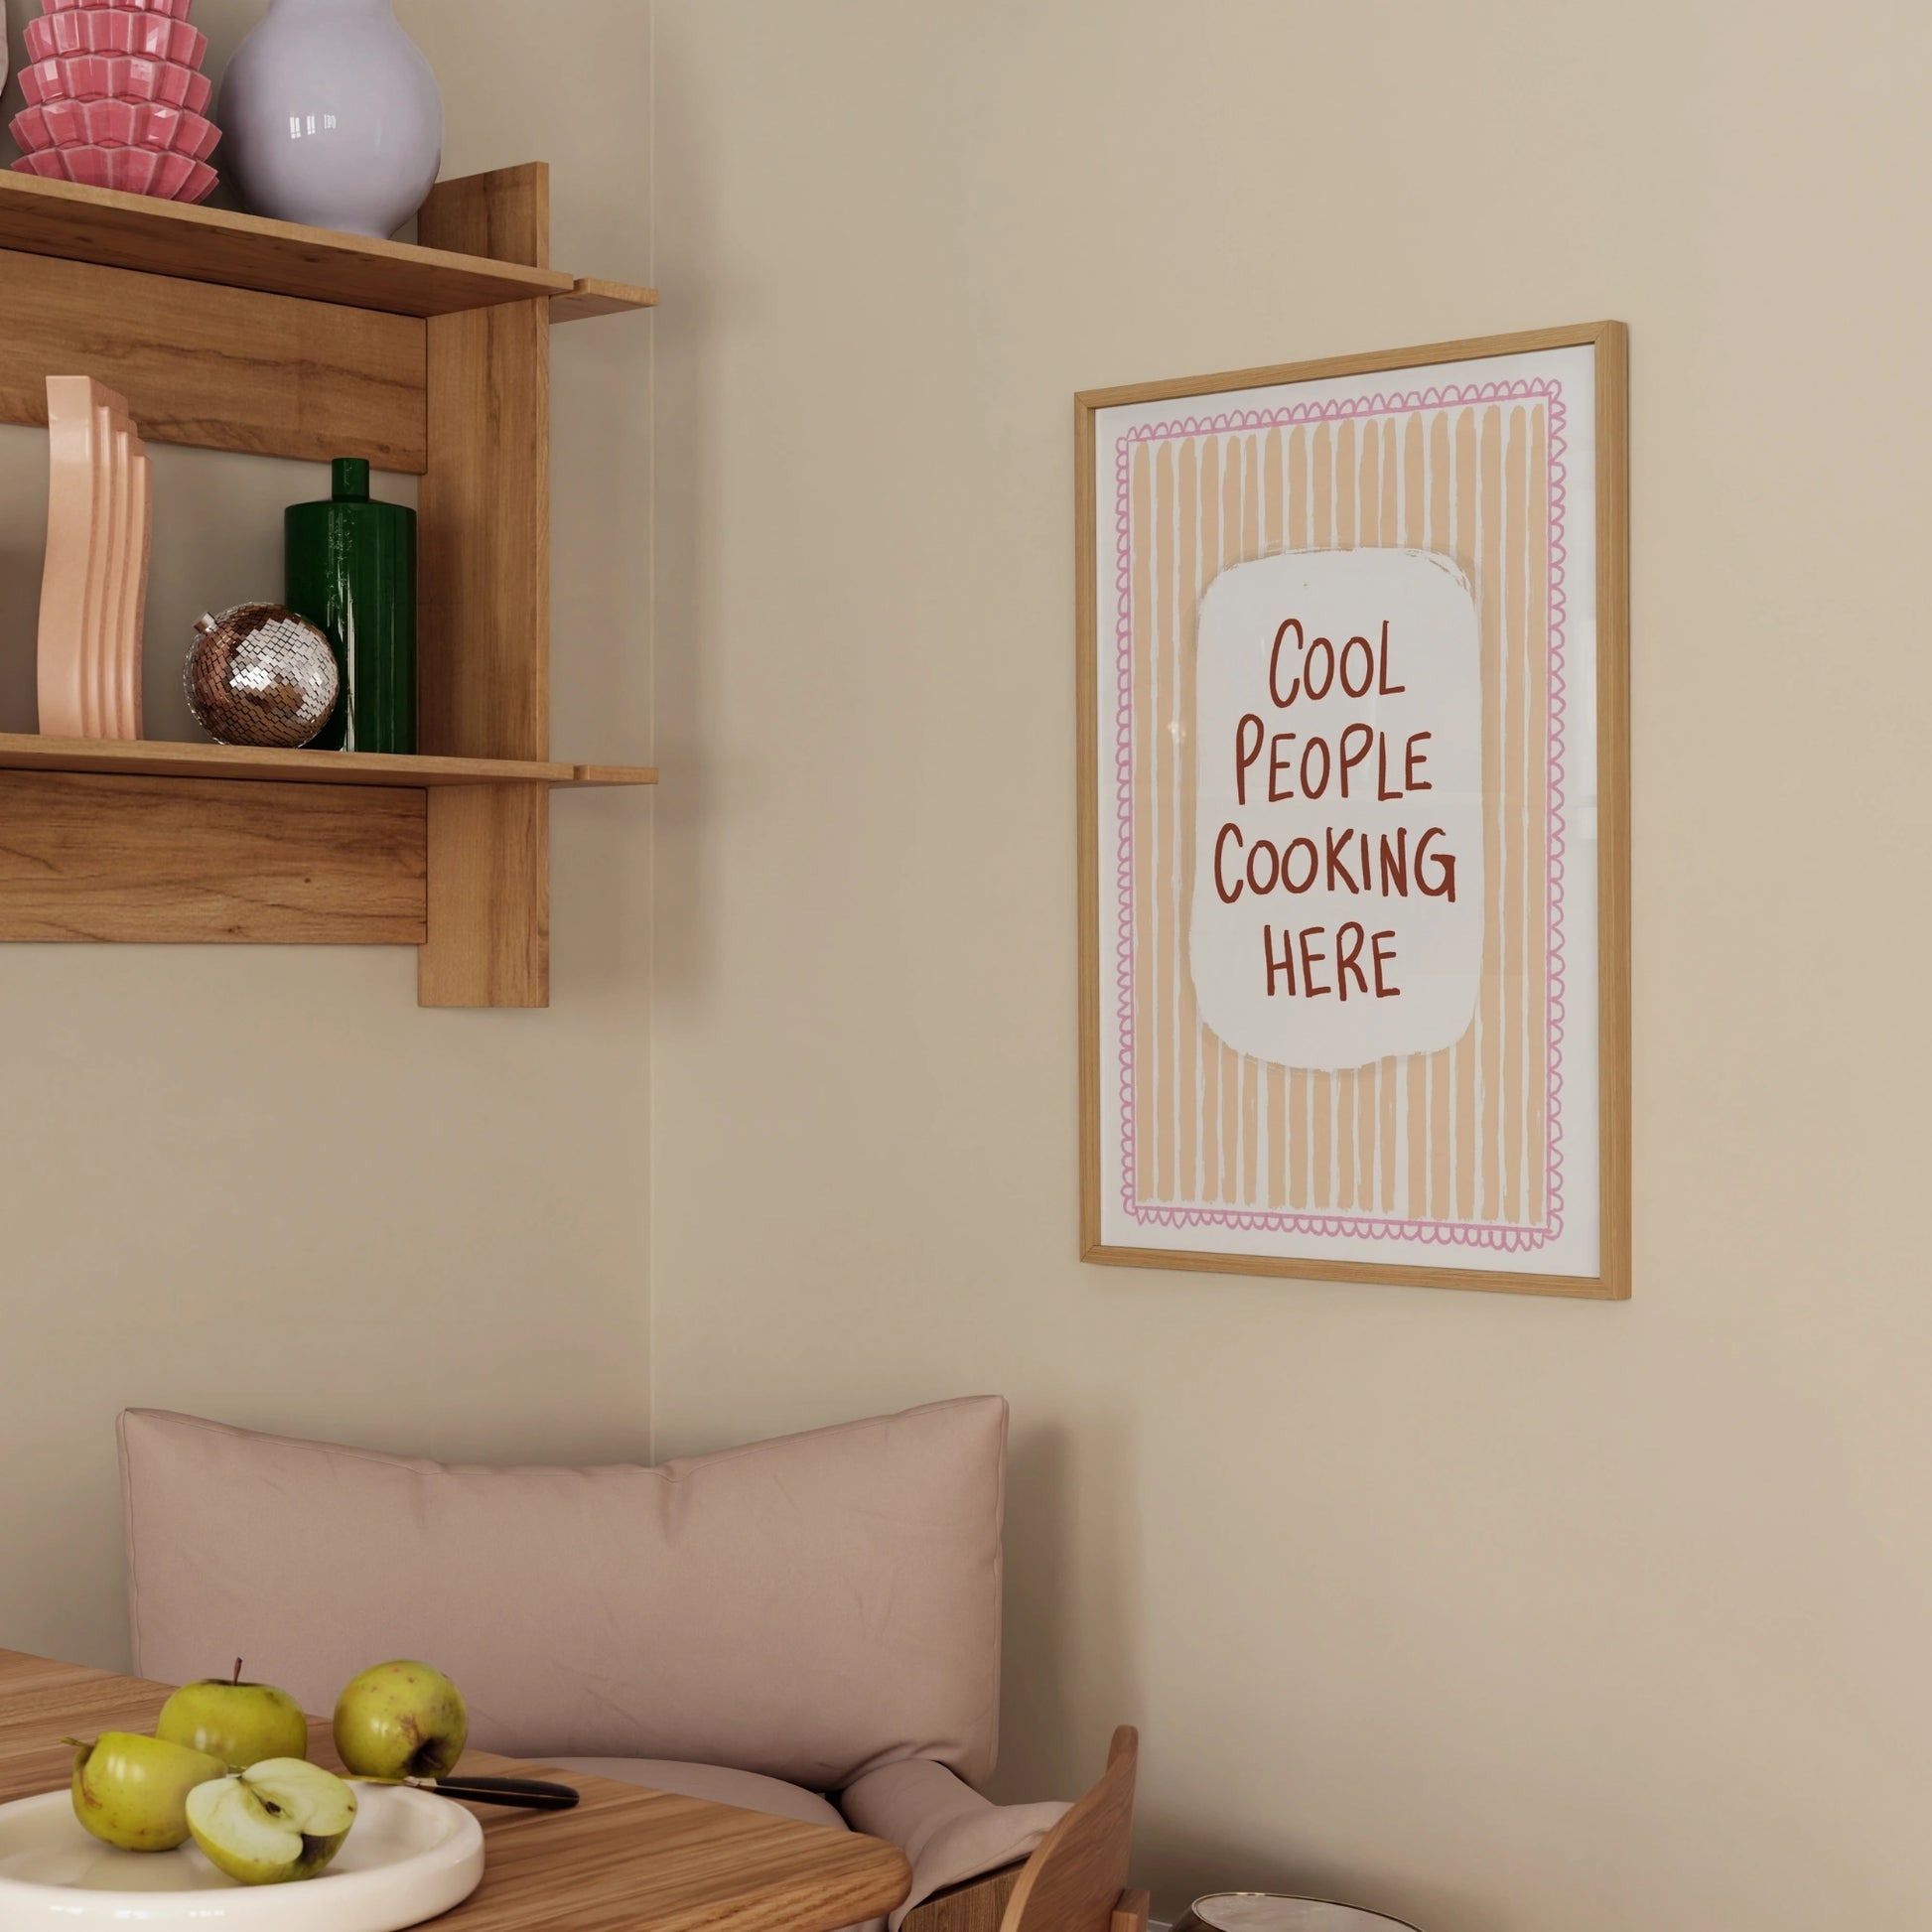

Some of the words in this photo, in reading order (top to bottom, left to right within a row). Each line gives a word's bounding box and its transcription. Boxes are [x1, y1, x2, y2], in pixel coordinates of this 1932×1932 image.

[1270, 619, 1405, 708] COOL
[1236, 714, 1432, 805] PEOPLE
[1214, 823, 1455, 903] COOKING
[1264, 921, 1400, 1001] HERE
